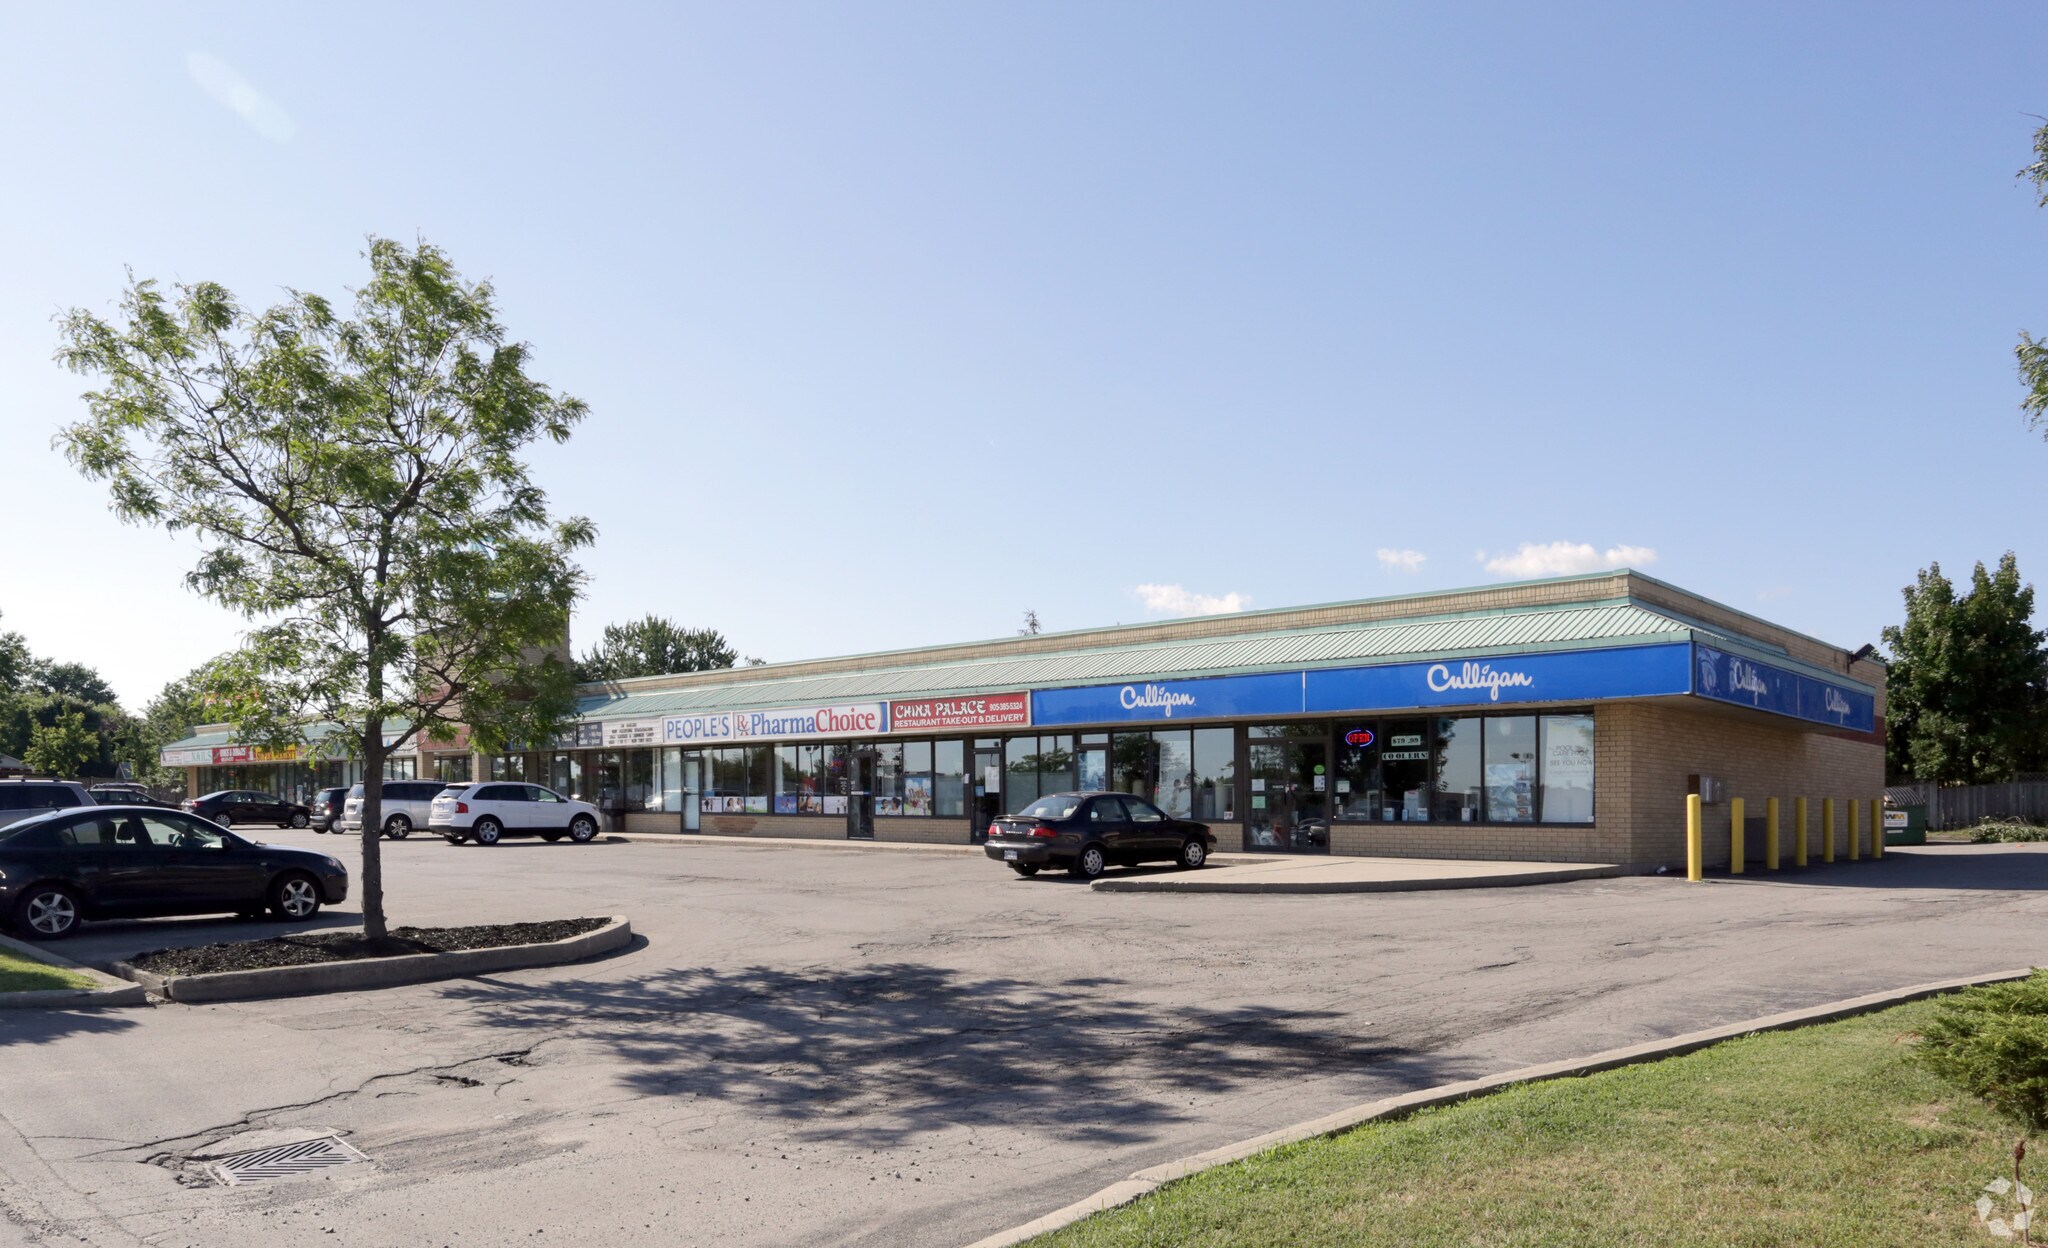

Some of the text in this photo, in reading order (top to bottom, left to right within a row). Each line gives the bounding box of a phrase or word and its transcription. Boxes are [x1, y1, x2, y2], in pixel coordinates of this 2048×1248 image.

[1427, 662, 1533, 701] Culligan
[1734, 660, 1768, 706] Culligan
[895, 703, 932, 719] CHINA
[935, 699, 986, 716] PALACE
[1120, 684, 1195, 717] Culligan
[1825, 687, 1851, 725] Culligan
[667, 715, 730, 739] PEOPLE'S
[750, 707, 876, 736] PharmaChoice
[894, 717, 940, 728] RESTAURANT
[978, 714, 985, 723] &
[985, 713, 1024, 722] DELIVERY
[1348, 733, 1370, 743] OPEN
[192, 749, 212, 762] NAILS
